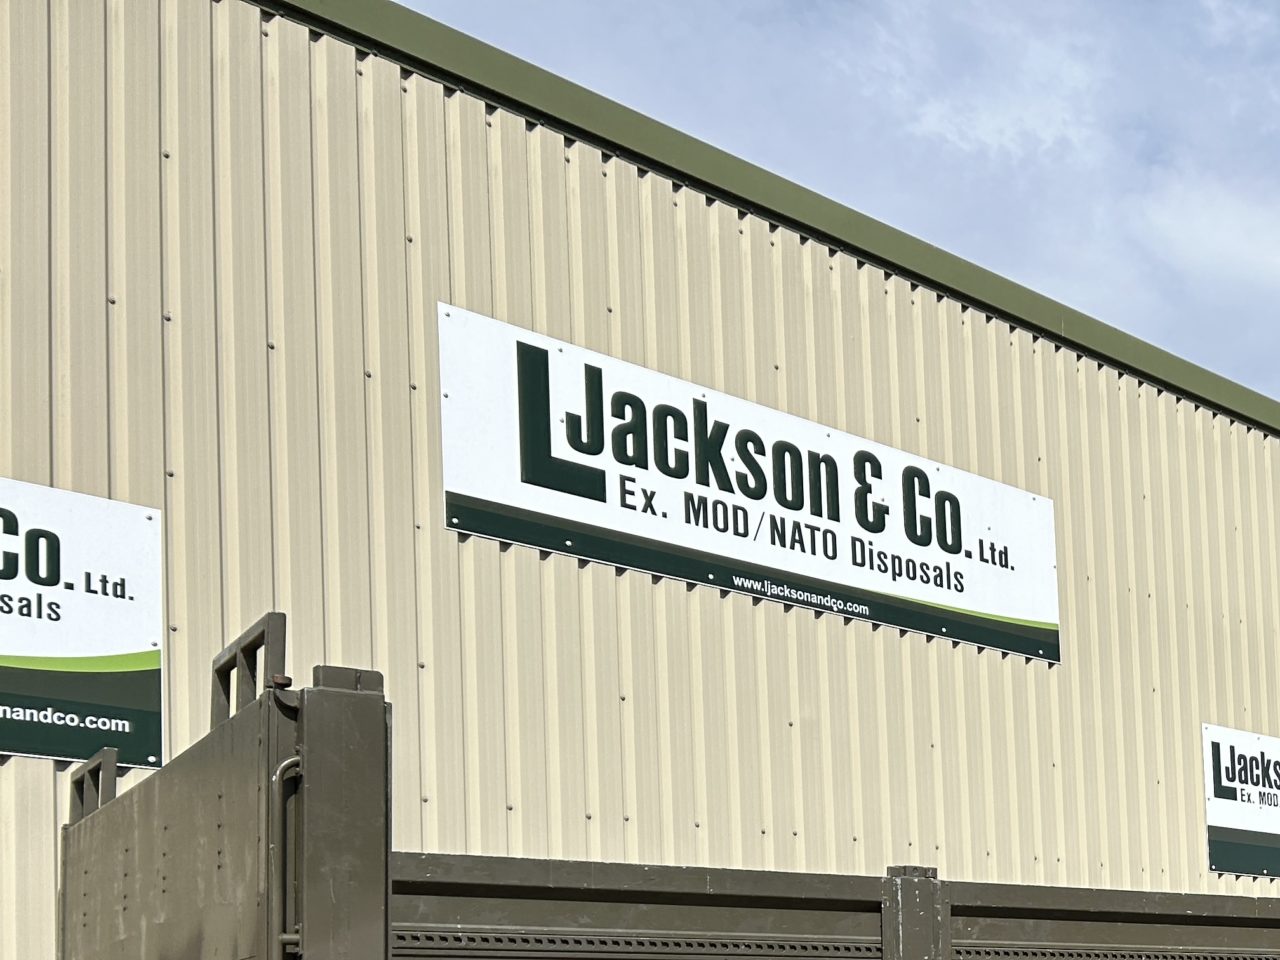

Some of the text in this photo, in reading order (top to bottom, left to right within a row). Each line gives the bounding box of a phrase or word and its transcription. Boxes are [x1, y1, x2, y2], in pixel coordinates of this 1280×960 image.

[853, 449, 890, 534] &
[902, 464, 973, 558] Co.
[979, 537, 1016, 571] Ltd.
[619, 476, 965, 593] Ex. MOD/NATO Disposals
[84, 571, 135, 601] Ltd.
[732, 575, 869, 616] www.ljacksonandco.com
[1240, 788, 1255, 804] Ex.
